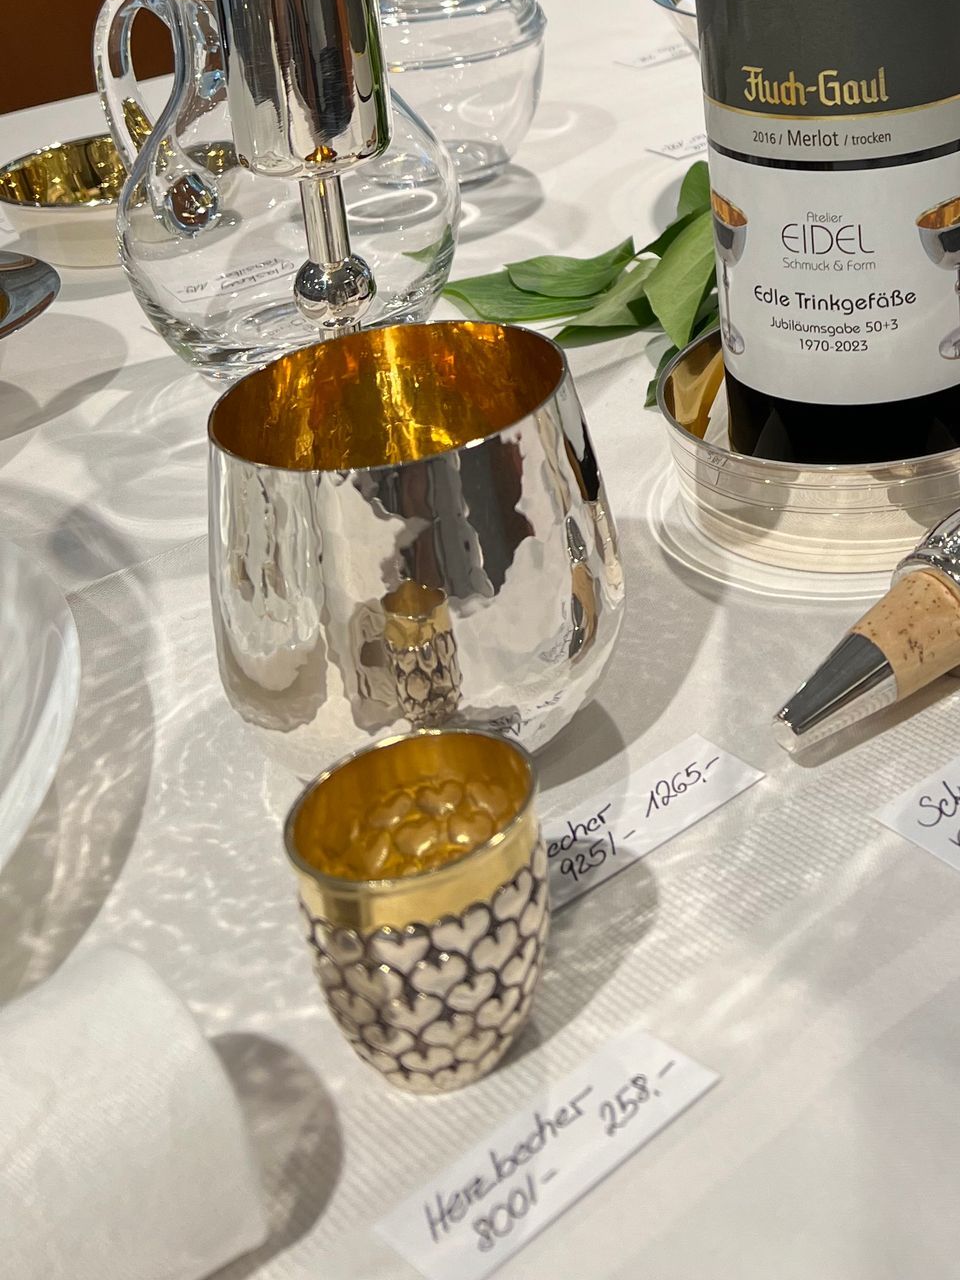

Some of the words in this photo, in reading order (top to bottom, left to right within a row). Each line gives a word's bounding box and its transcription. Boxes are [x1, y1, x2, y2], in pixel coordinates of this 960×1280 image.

[741, 65, 889, 107] Fluch-Gaul
[752, 130, 776, 145] 2016
[787, 129, 839, 147] Merlot
[852, 131, 892, 146] trocken
[806, 211, 844, 223] Atelier
[781, 223, 875, 255] EIDEL
[782, 257, 830, 271] Schmuck
[833, 260, 843, 271] &
[847, 261, 876, 271] Form
[754, 285, 790, 307] Edle
[795, 289, 917, 316] Trinkgefäße
[770, 316, 861, 337] Jubiläumsgabe
[865, 318, 899, 333] 50+3
[799, 338, 868, 352] 1970-2023
[547, 802, 611, 859] echer
